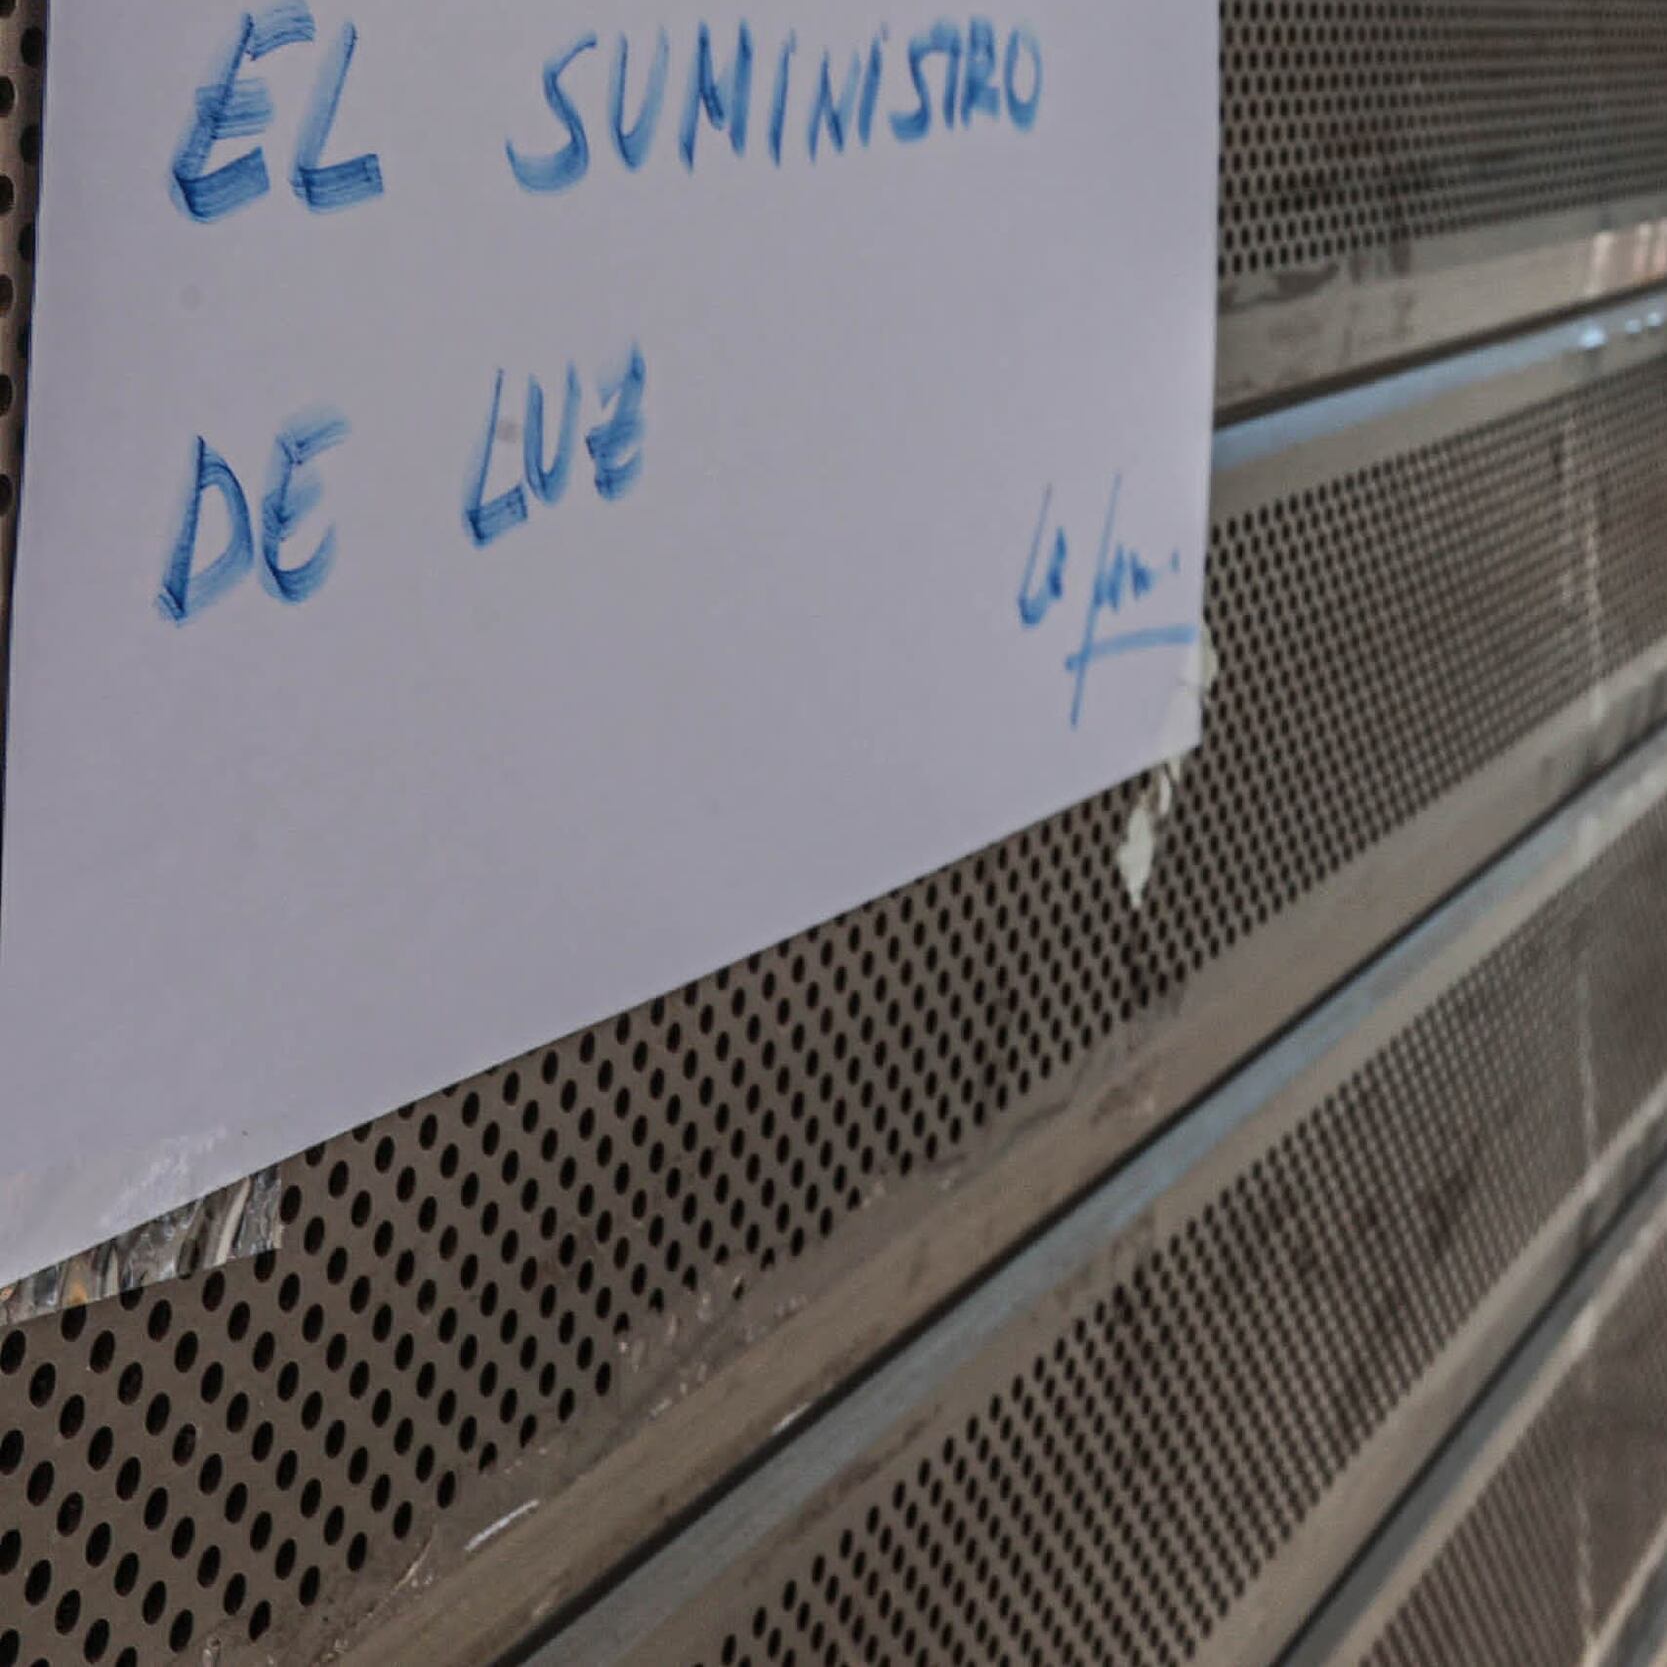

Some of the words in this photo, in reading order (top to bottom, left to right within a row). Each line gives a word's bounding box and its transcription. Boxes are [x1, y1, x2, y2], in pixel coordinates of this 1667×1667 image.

[505, 15, 1043, 195] SUMINISTRO
[156, 402, 350, 626] DE
[461, 340, 647, 549] LUZ
